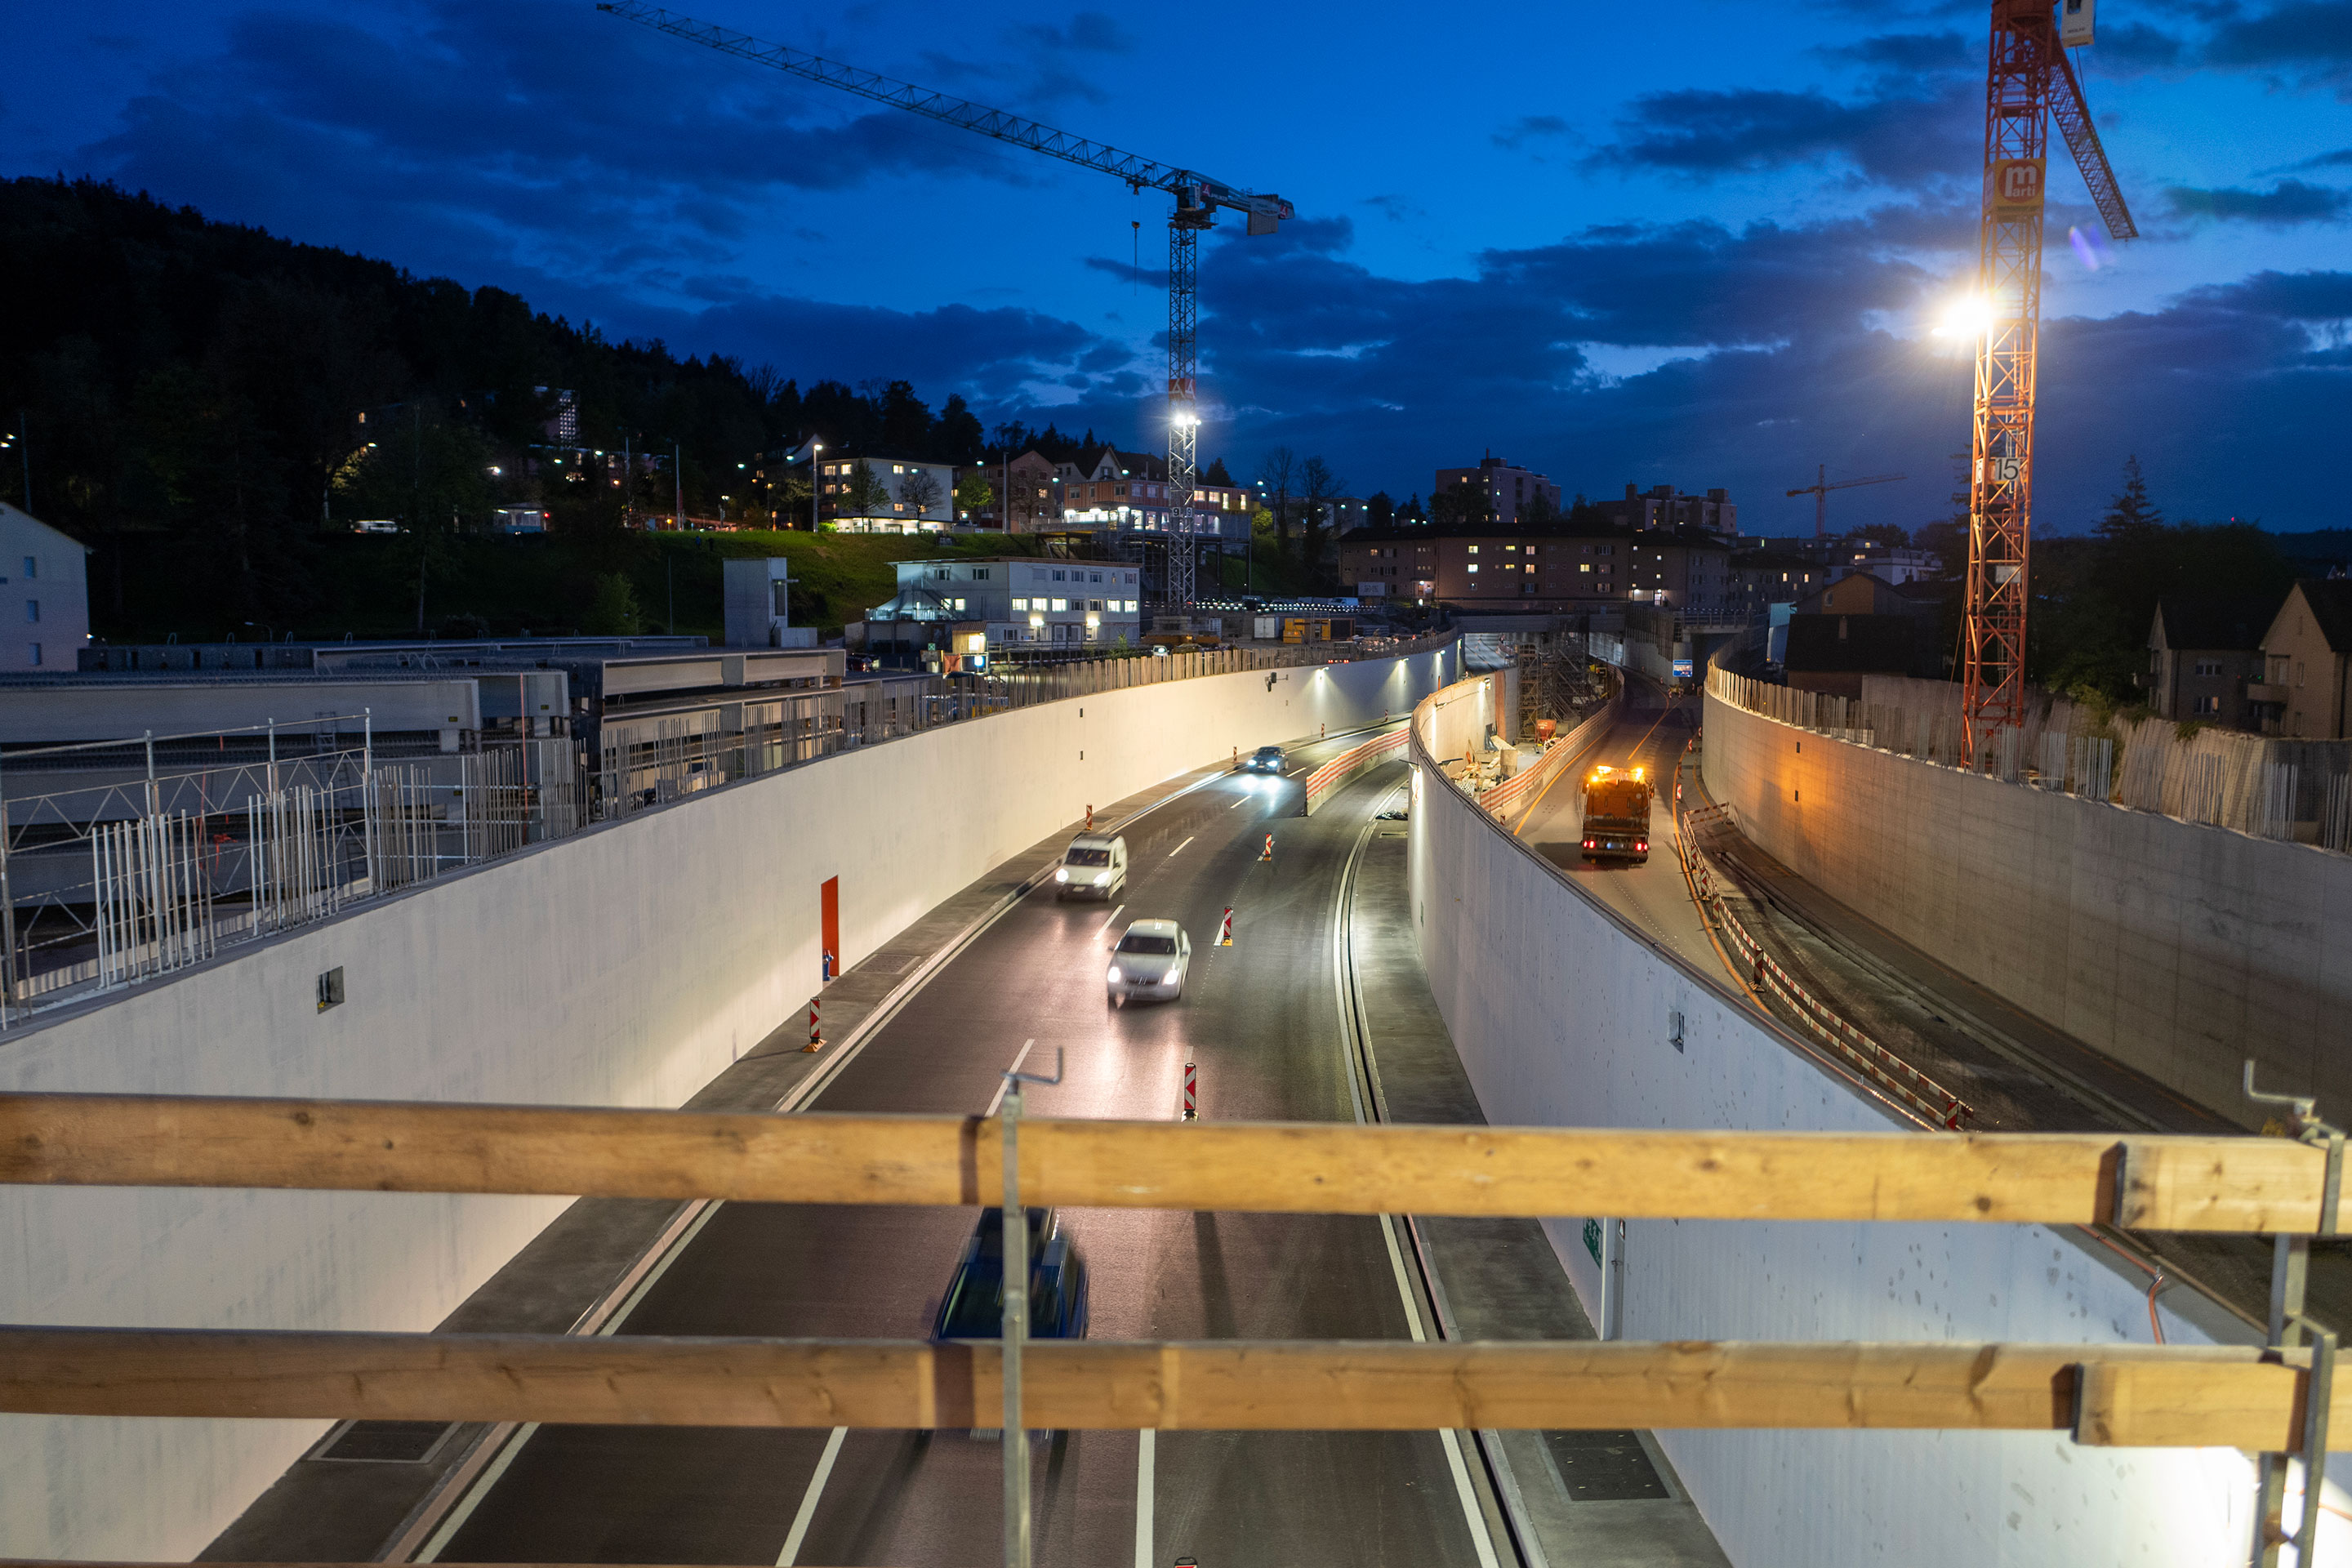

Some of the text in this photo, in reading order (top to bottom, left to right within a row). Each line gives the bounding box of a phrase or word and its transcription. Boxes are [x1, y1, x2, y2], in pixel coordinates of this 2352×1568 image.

[2004, 166, 2038, 198] marti
[1996, 458, 2019, 480] 15
[1173, 508, 1179, 516] 9
[1187, 508, 1192, 516] 9
